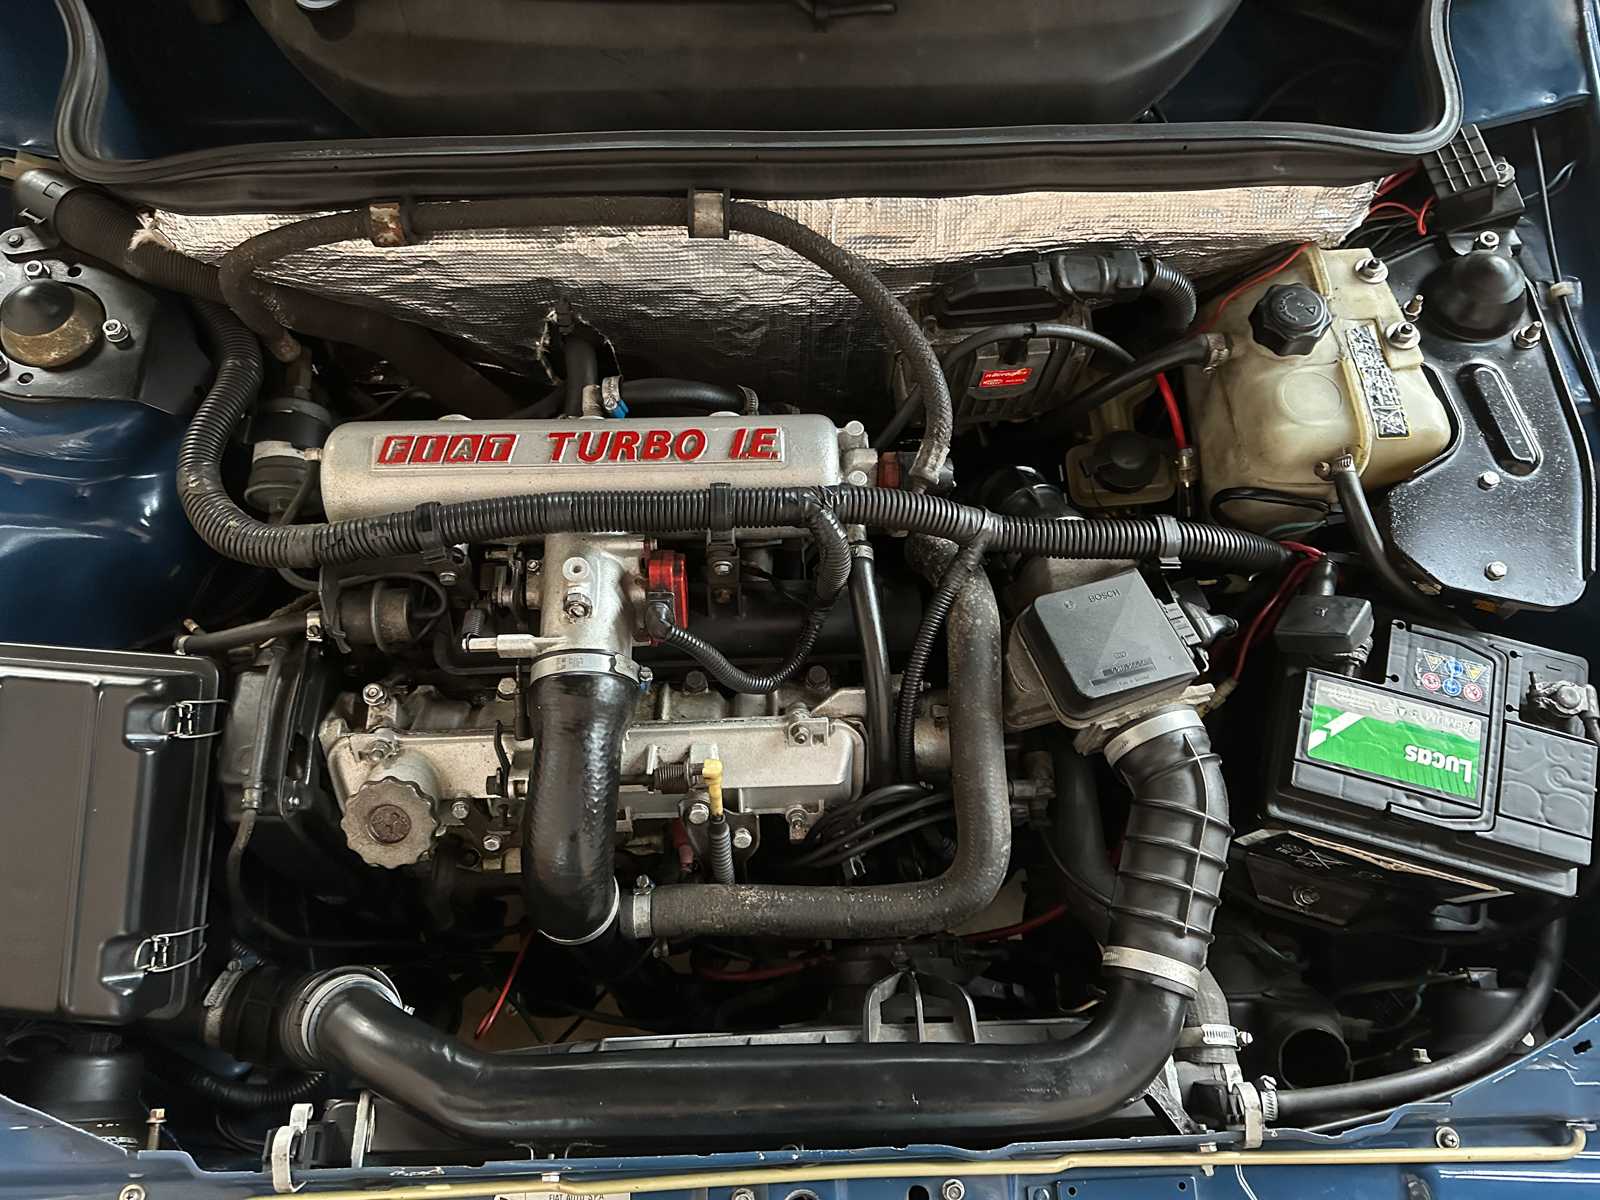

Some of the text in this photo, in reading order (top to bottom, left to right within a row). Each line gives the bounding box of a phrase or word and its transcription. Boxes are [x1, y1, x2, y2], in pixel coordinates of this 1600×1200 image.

[379, 434, 518, 464] FIAT
[548, 428, 709, 464] TURBO
[1087, 588, 1121, 603] BOSCH
